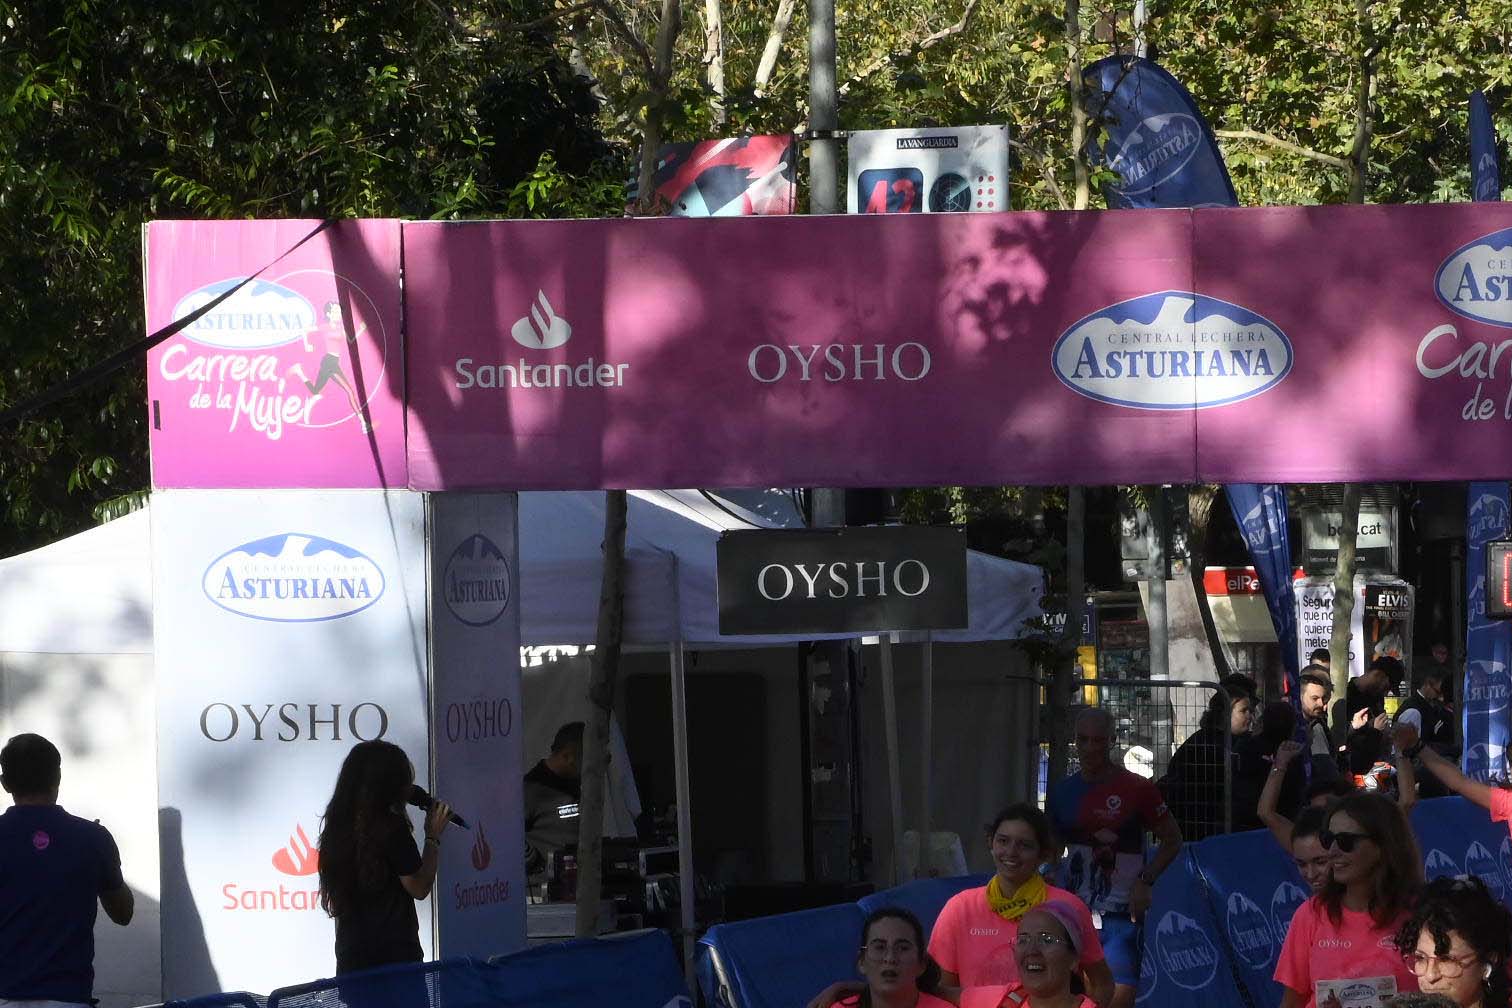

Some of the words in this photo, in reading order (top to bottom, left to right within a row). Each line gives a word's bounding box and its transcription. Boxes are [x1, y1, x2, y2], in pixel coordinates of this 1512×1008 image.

[1107, 332, 1184, 344] CENTRAL
[1191, 331, 1267, 343] LECHERA
[160, 344, 279, 381] Carrera
[455, 357, 630, 390] Santander
[747, 342, 931, 383] OYSHO
[1072, 337, 1274, 379] ASTURIANA
[189, 383, 212, 409] de
[216, 383, 233, 409] la
[228, 378, 324, 441] Mujer
[1461, 384, 1495, 421] de
[216, 566, 372, 600] ASTURIANA
[452, 566, 507, 605] ASTURIANA
[757, 559, 931, 602] OYSHO
[1303, 611, 1320, 622] que
[1378, 594, 1410, 607] ELVIS
[199, 702, 389, 743] OYSHO
[446, 698, 512, 743] OYSHO
[454, 879, 510, 910] Santander
[1318, 938, 1352, 949] OYSHO
